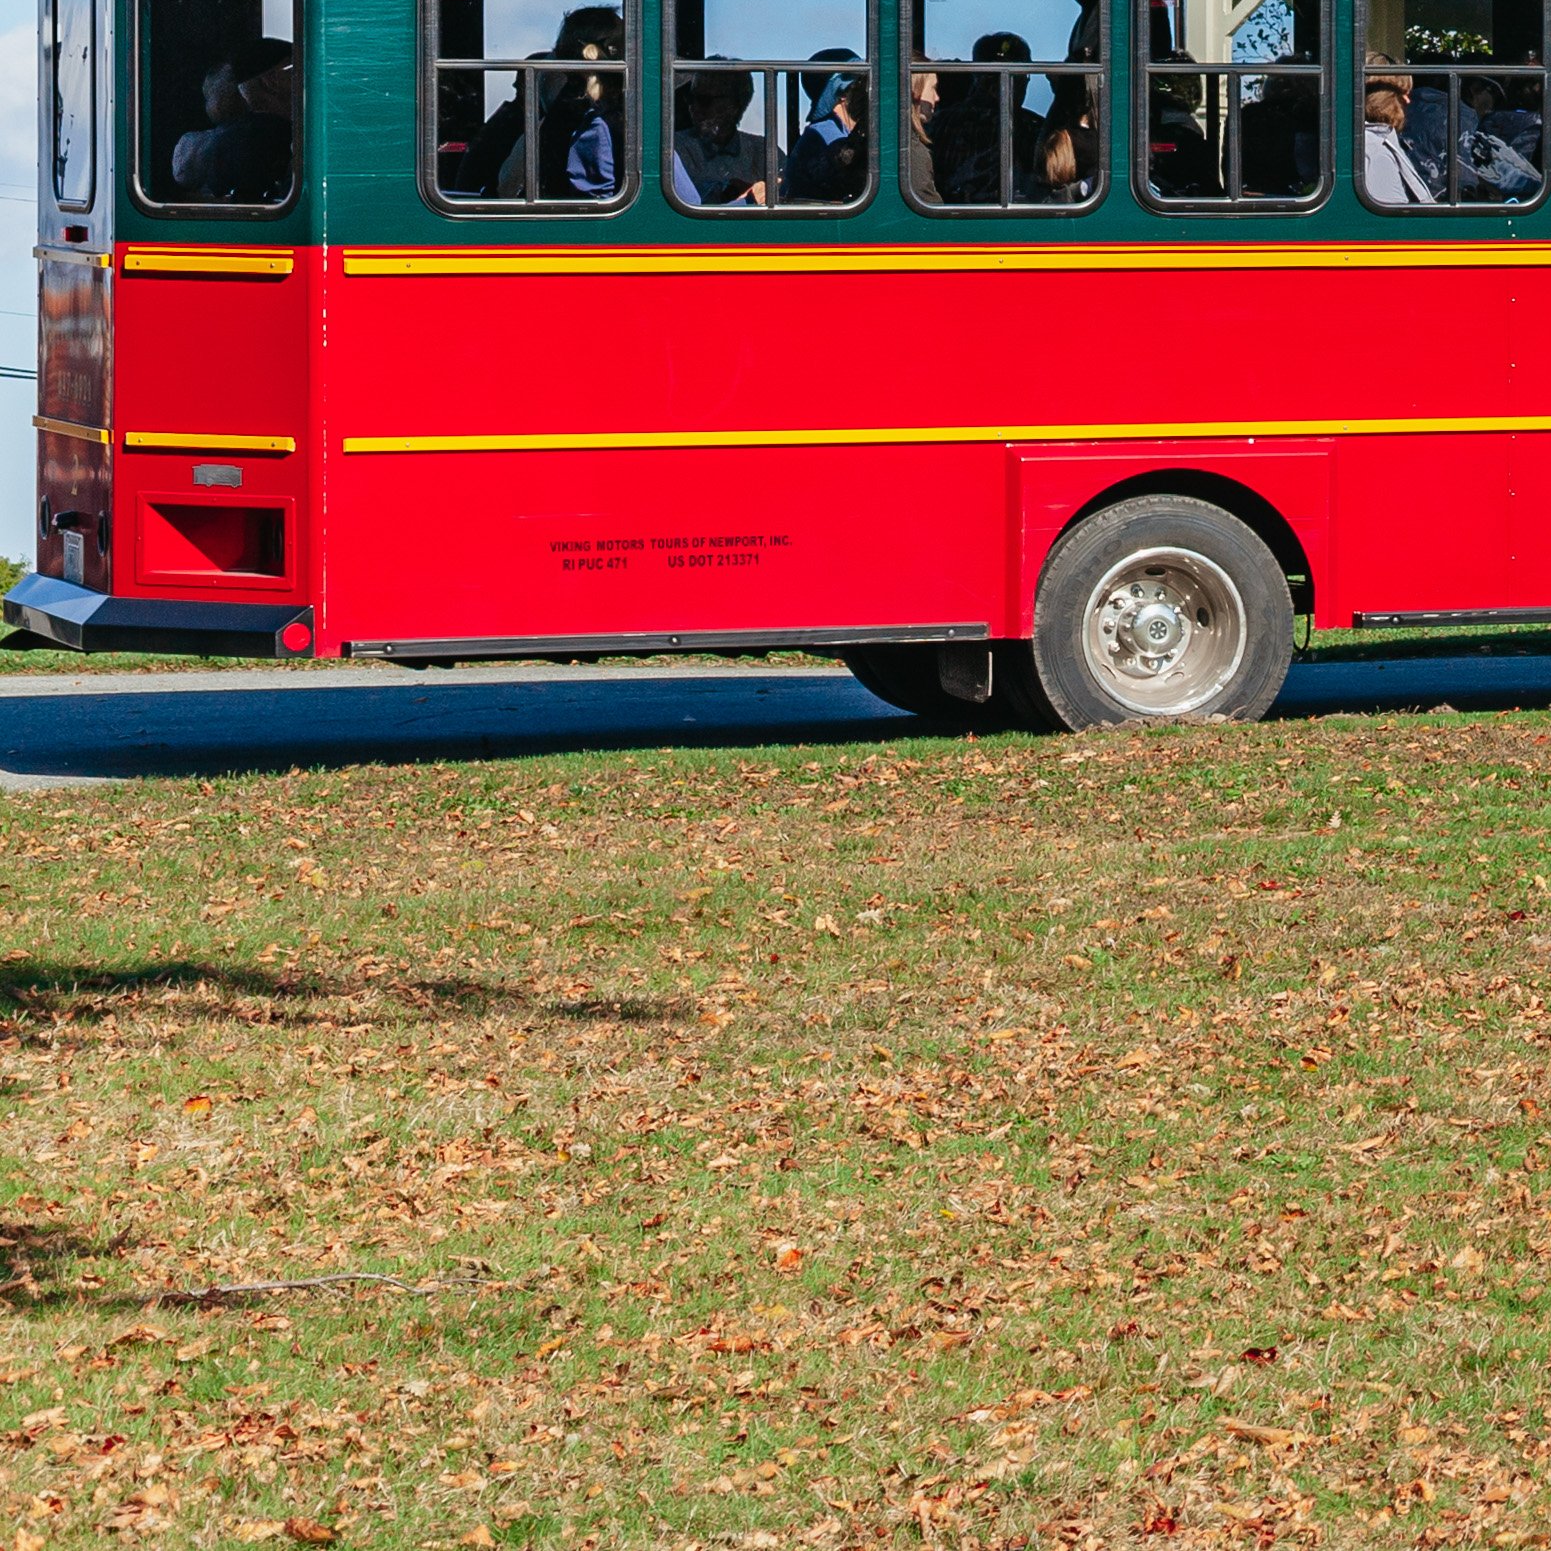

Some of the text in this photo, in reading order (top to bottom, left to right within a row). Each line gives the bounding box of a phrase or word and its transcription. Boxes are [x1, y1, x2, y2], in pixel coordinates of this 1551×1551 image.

[550, 535, 793, 552] VIKING MOTORS TOURS OF NEWPORT, INC.
[563, 553, 759, 570] RI PUC 471 US DOT 213371
